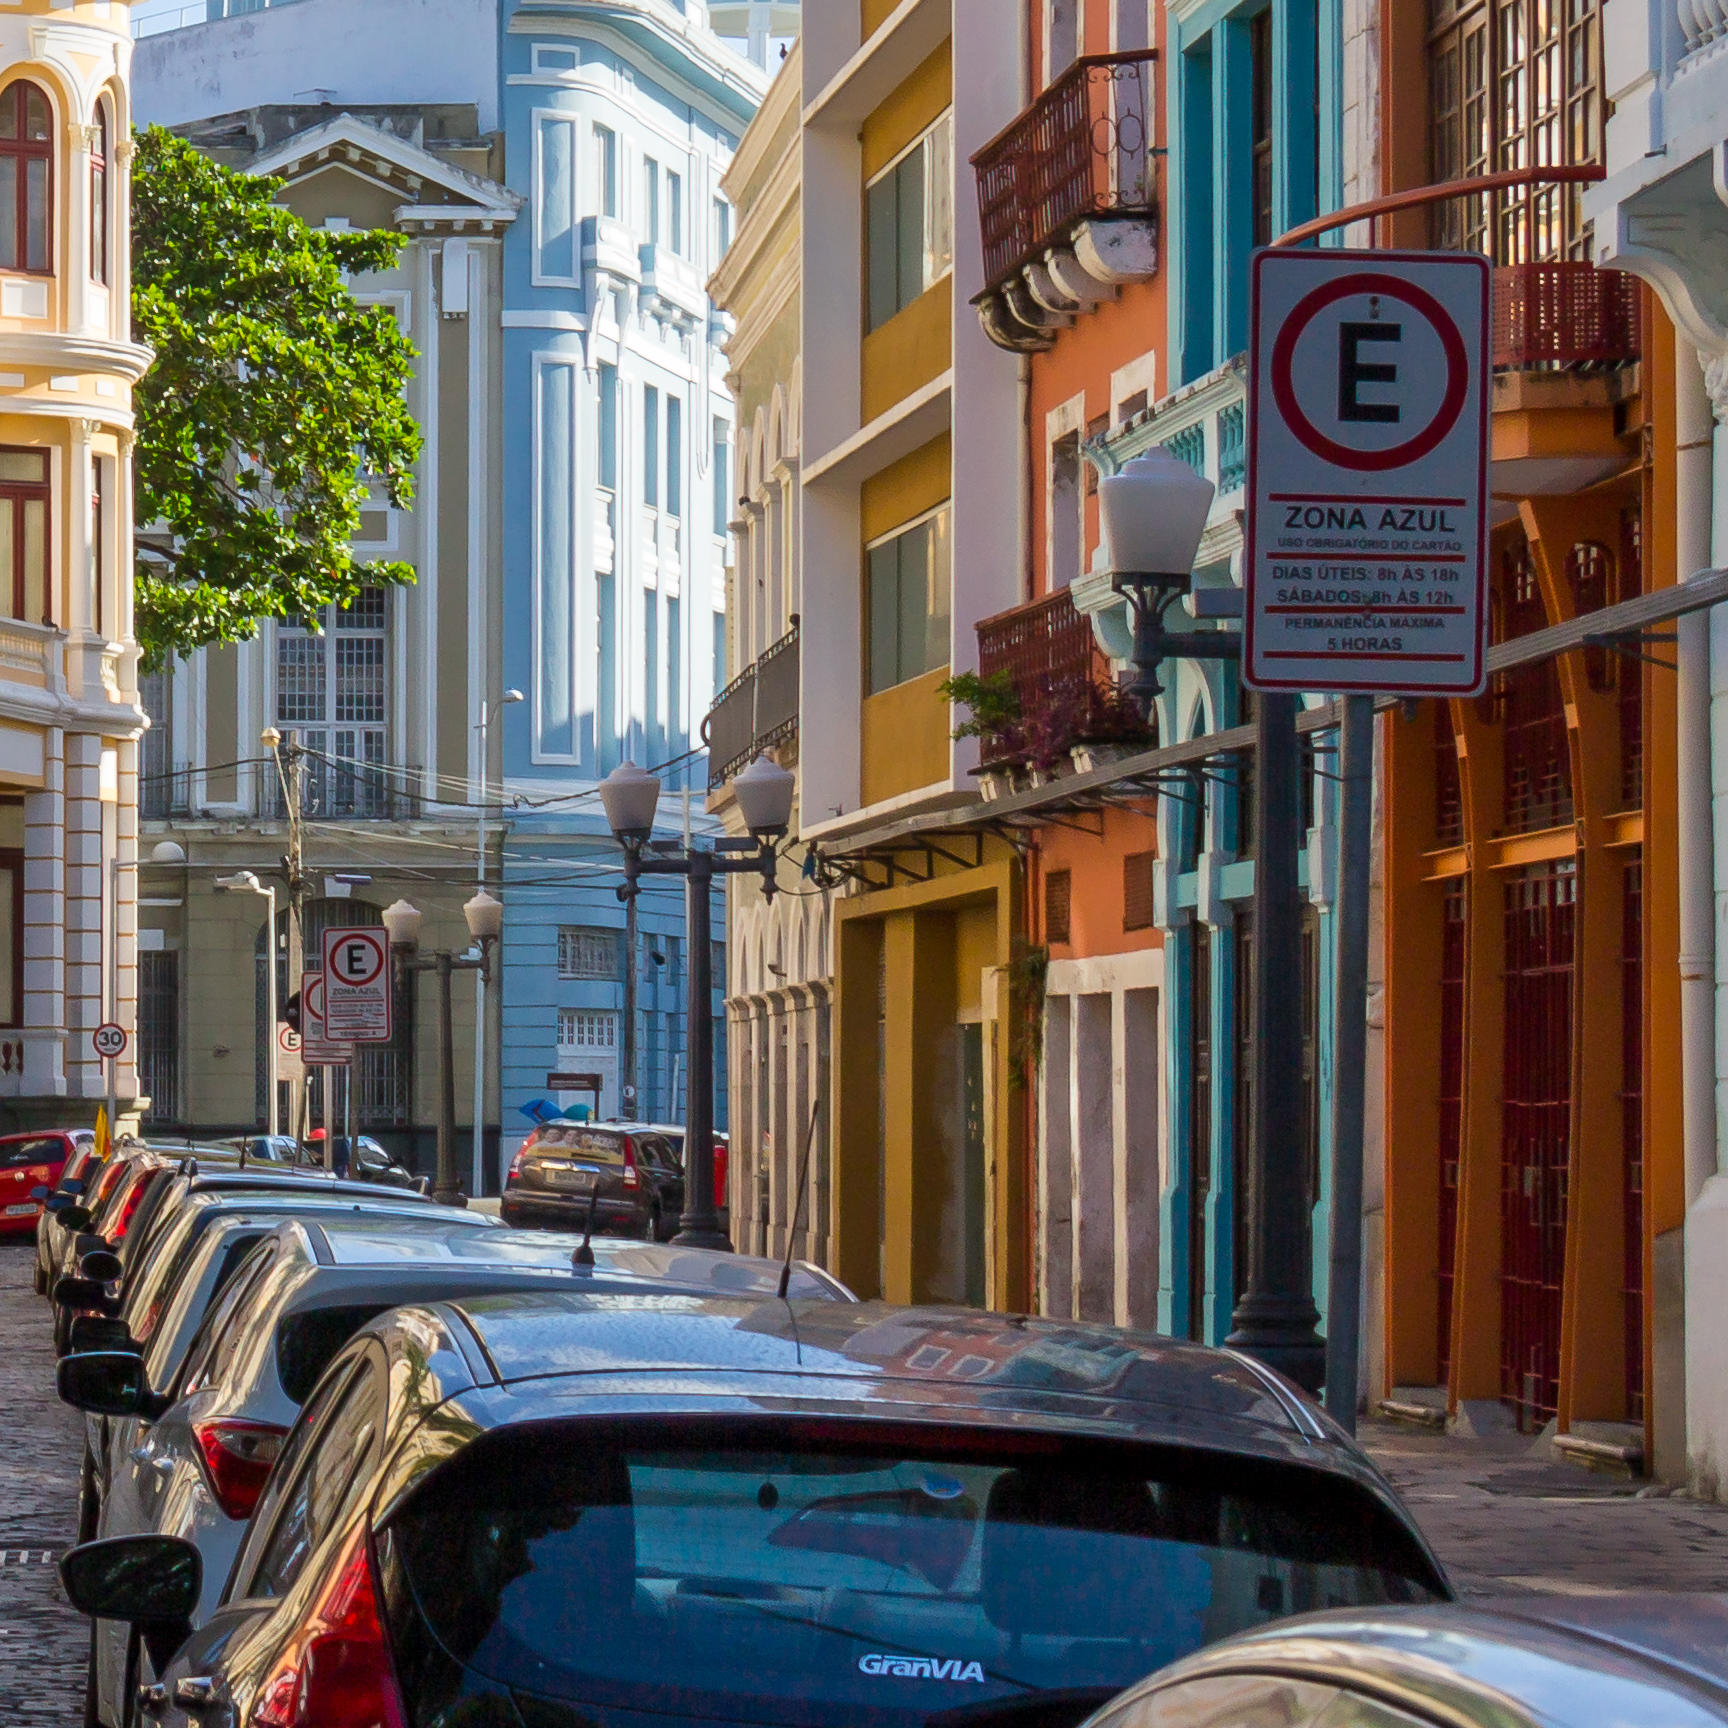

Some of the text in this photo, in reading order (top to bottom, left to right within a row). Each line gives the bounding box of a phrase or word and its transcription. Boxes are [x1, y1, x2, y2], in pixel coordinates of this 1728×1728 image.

[1338, 321, 1401, 423] E
[1285, 506, 1455, 532] ZONA AZUL
[1277, 536, 1462, 551] USO OBRIGATÓRIO DO CARTÃO
[1272, 563, 1458, 581] DIAS ÚTEIS: 8h ÀS 18h
[1370, 590, 1392, 603] 8h
[1396, 587, 1419, 603] ÀS
[1425, 591, 1453, 604] 12h
[1285, 616, 1386, 629] PERMANÊNCIA
[1328, 638, 1402, 650] 5 HORAS
[347, 944, 368, 974] E
[98, 1031, 123, 1047] 30
[288, 1033, 297, 1047] E
[858, 1654, 985, 1683] GranVIA
